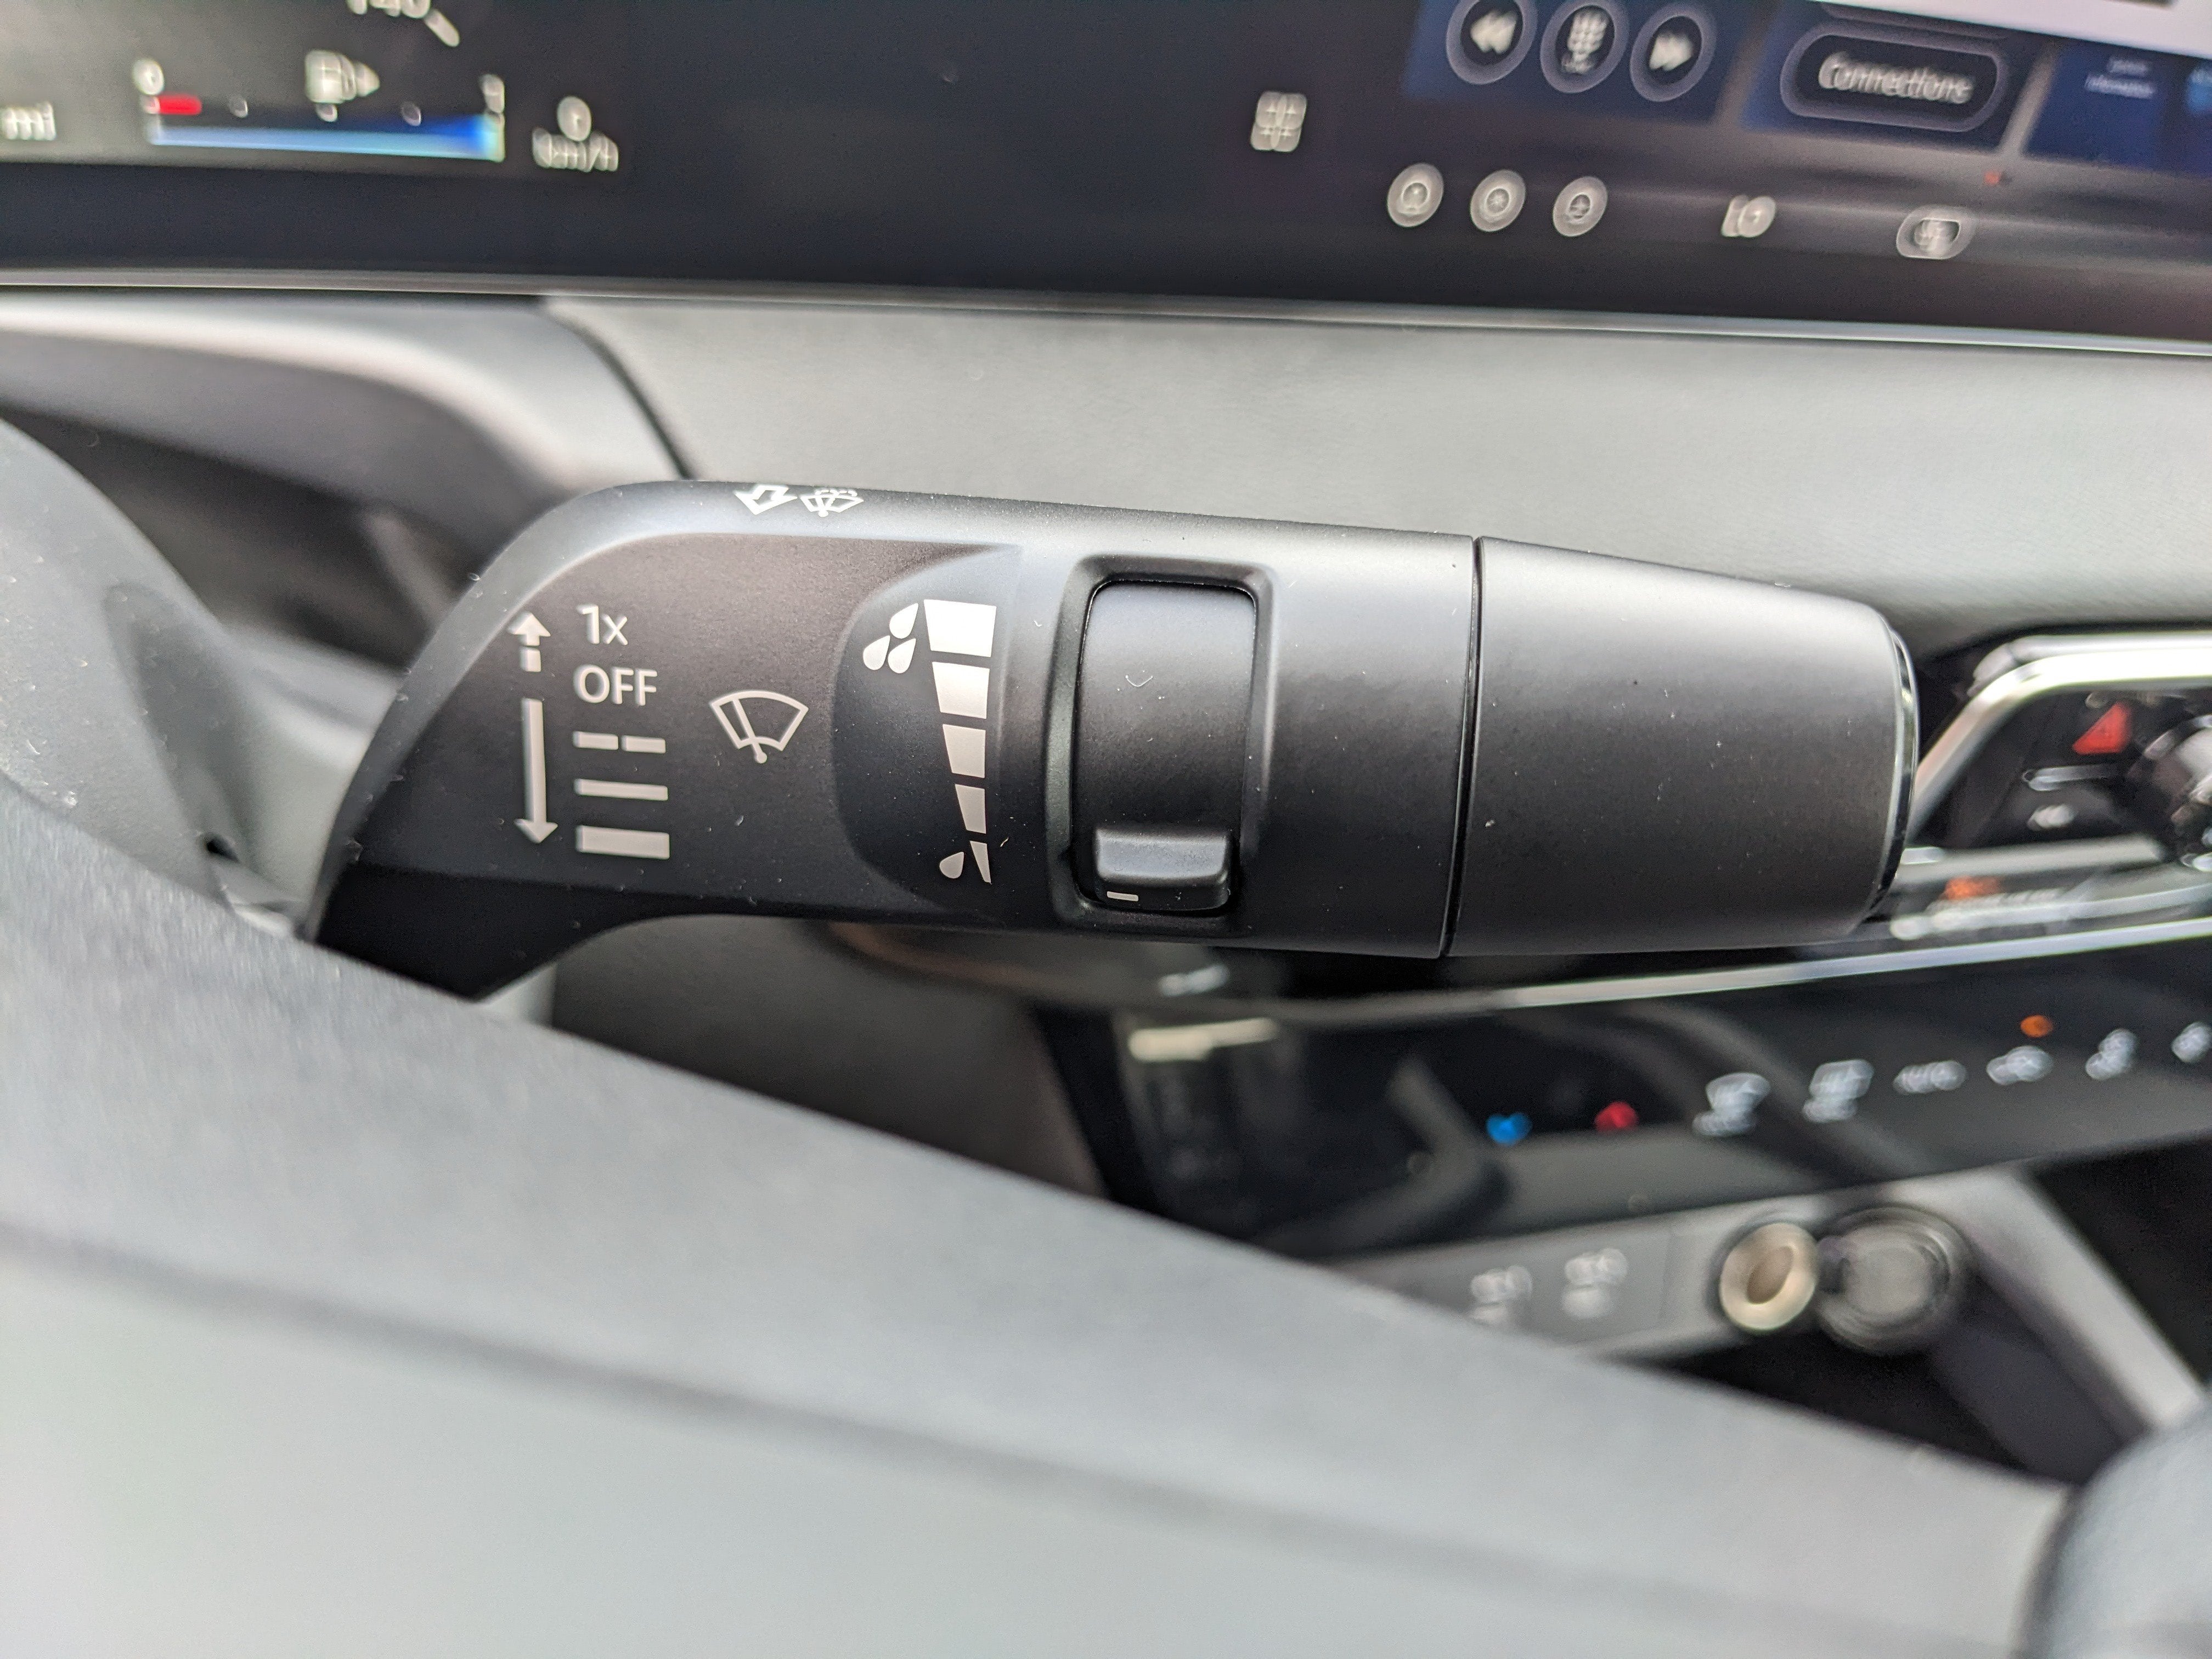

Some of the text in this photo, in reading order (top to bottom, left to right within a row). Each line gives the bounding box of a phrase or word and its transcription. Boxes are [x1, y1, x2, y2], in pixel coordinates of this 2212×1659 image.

[1818, 51, 1973, 104] Connections
[577, 604, 628, 645] 1x
[574, 664, 657, 706] OFF
